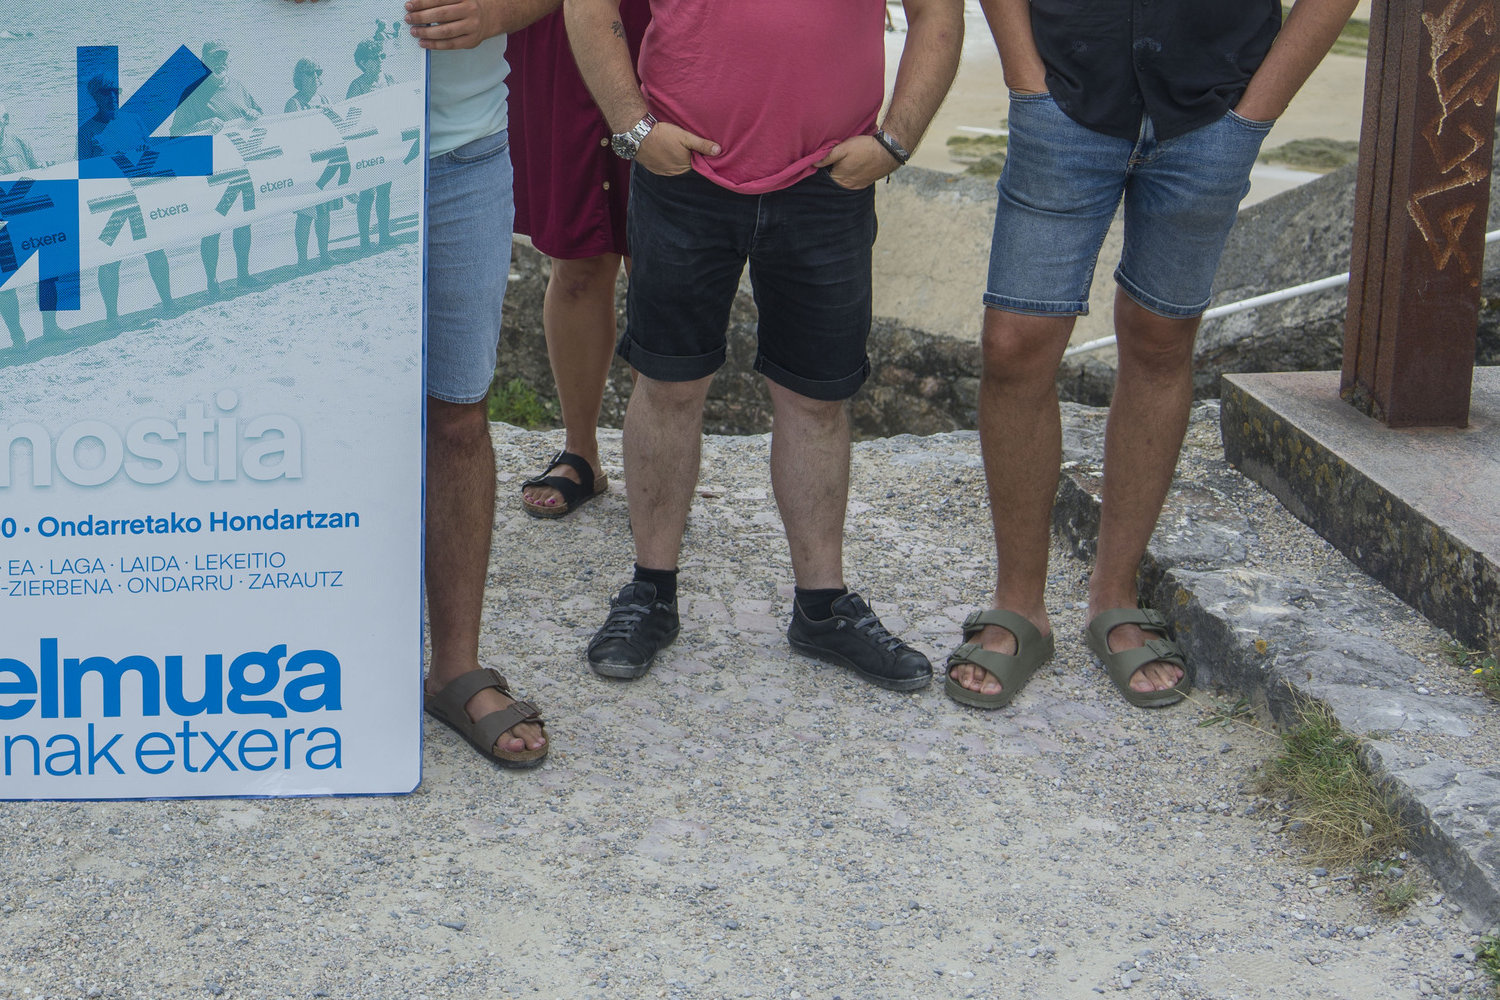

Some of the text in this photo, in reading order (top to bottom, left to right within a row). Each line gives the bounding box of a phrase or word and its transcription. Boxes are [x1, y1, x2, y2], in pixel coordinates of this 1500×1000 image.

[355, 155, 385, 170] etxera
[260, 178, 294, 193] etxera
[150, 203, 189, 220] etxera
[21, 232, 67, 250] etxera
[37, 512, 201, 538] Ondarretako
[209, 509, 360, 532] Hondartzan
[8, 559, 35, 576] EA
[50, 557, 106, 575] LAGA
[120, 555, 180, 573] LAIDA
[195, 551, 286, 570] LEKEITIO
[127, 574, 233, 593] ONDARRU
[248, 571, 344, 590] ZARAUTZ
[135, 720, 342, 775] etxera
